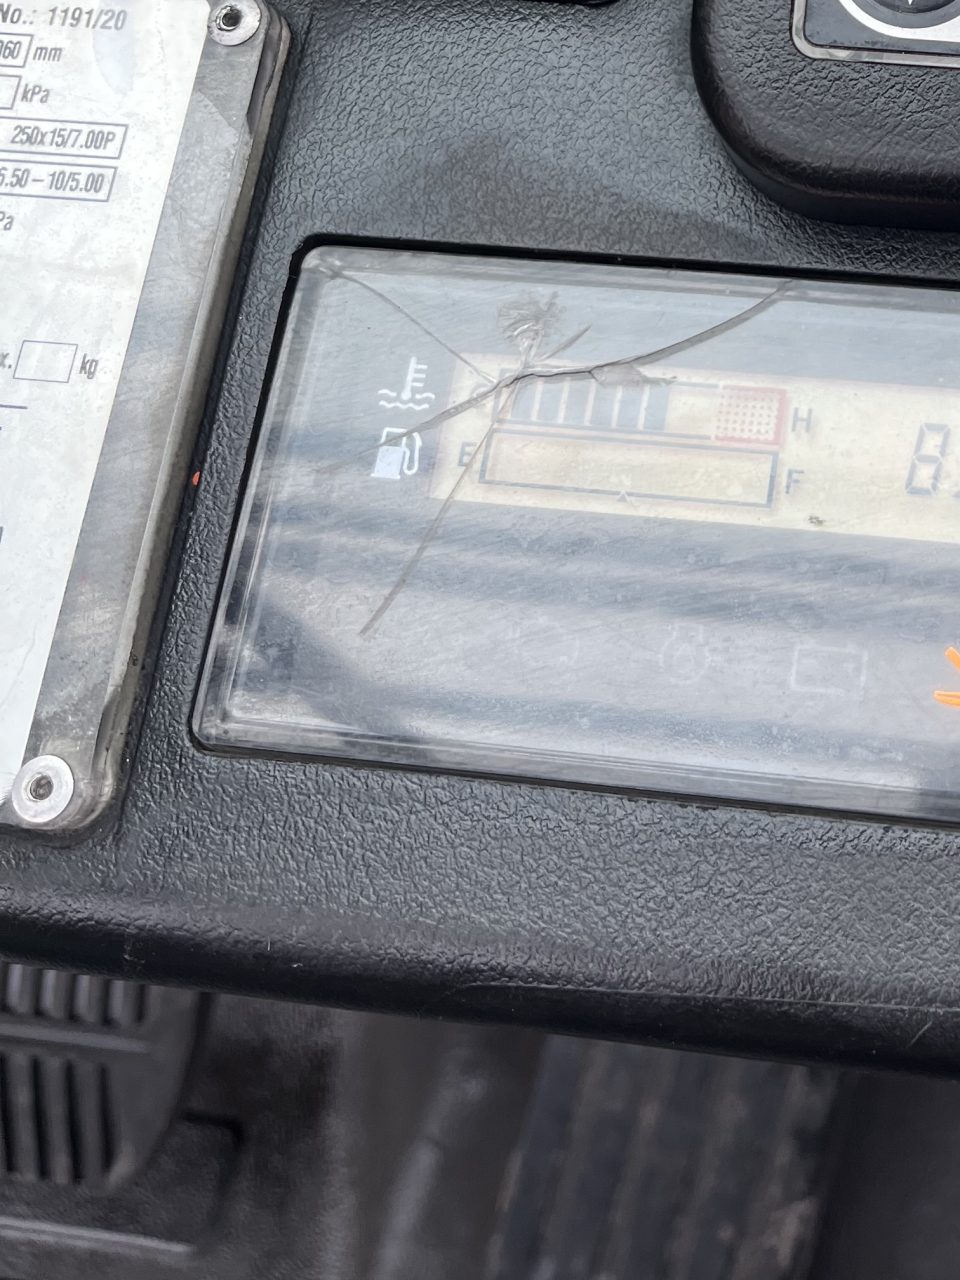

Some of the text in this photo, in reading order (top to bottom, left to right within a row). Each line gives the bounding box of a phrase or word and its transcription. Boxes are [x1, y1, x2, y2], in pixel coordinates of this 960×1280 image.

[48, 5, 128, 31] 1191/20
[32, 46, 63, 62] mm
[20, 83, 51, 104] kPa
[10, 124, 117, 151] 250x15/7.00P
[47, 170, 105, 194] 10/5.00
[79, 352, 99, 380] kg
[791, 407, 813, 433] H
[784, 469, 804, 495] F
